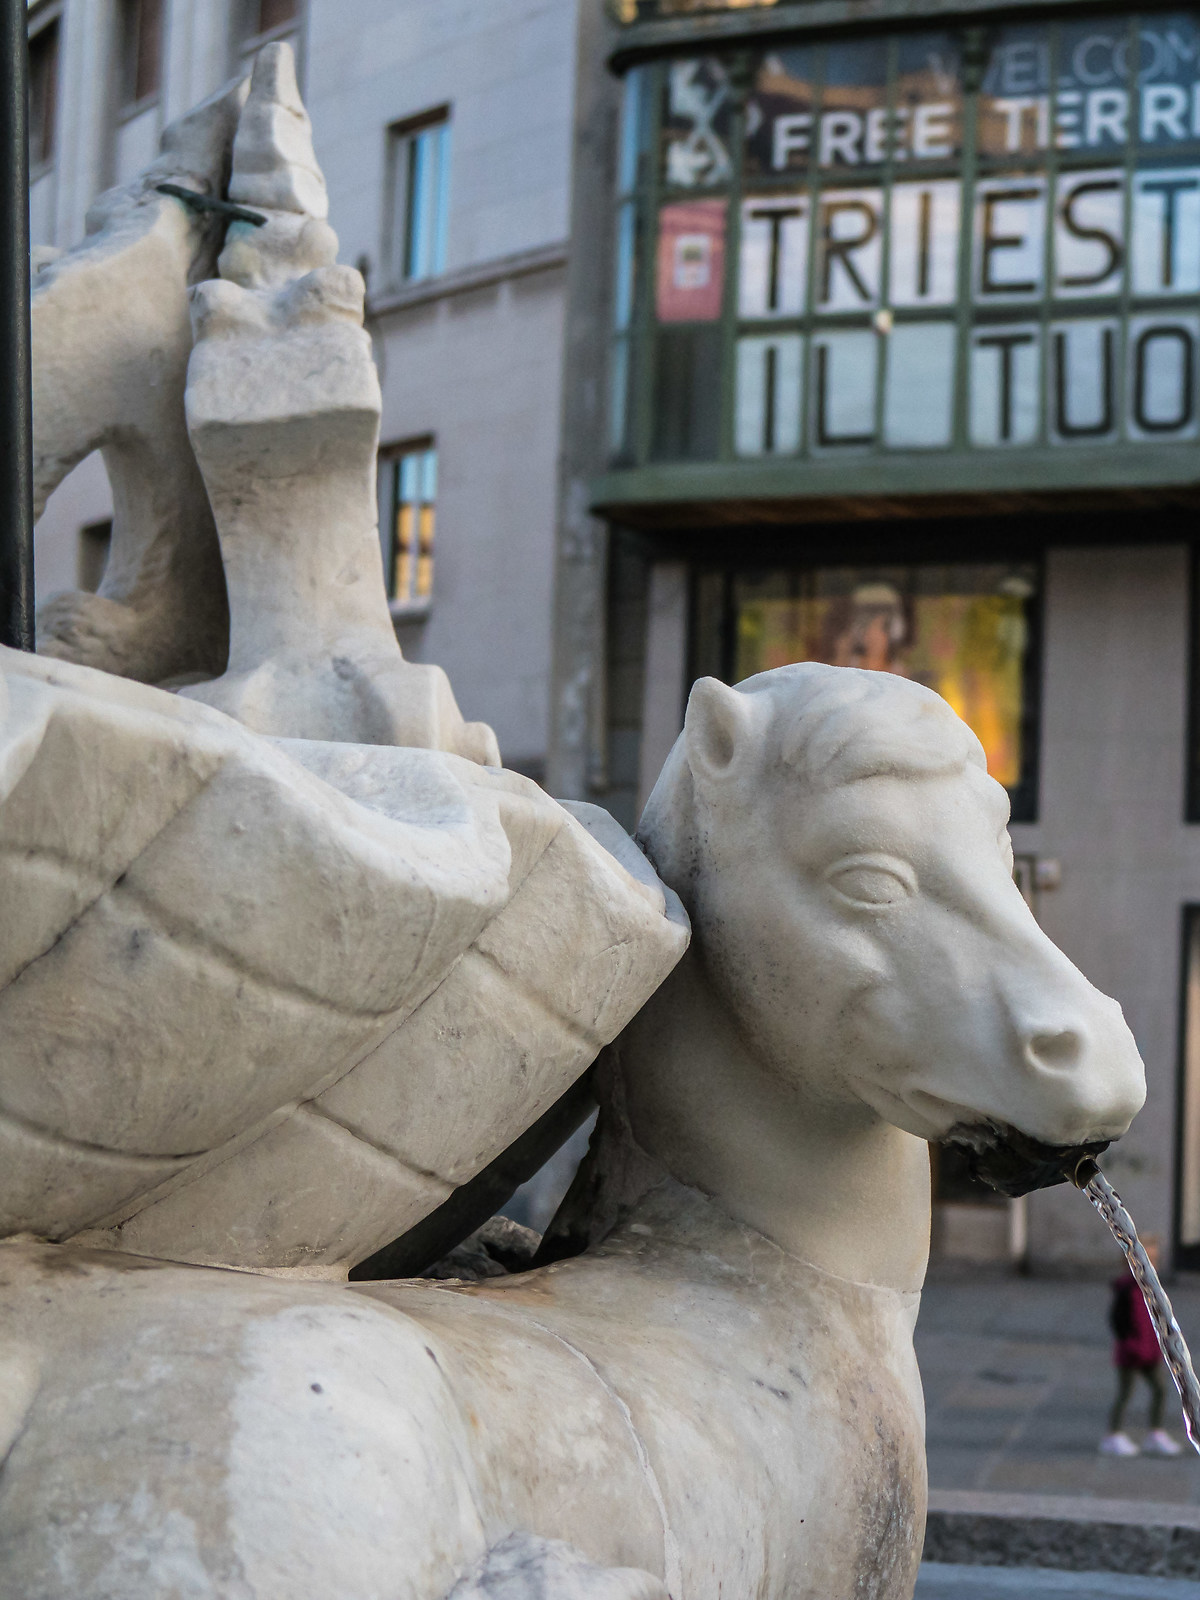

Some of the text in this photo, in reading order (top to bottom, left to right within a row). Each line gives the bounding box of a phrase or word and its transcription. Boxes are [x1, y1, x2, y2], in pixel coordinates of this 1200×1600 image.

[771, 100, 957, 171] FREE
[766, 344, 875, 452] IL
[977, 326, 1194, 442] TUO
